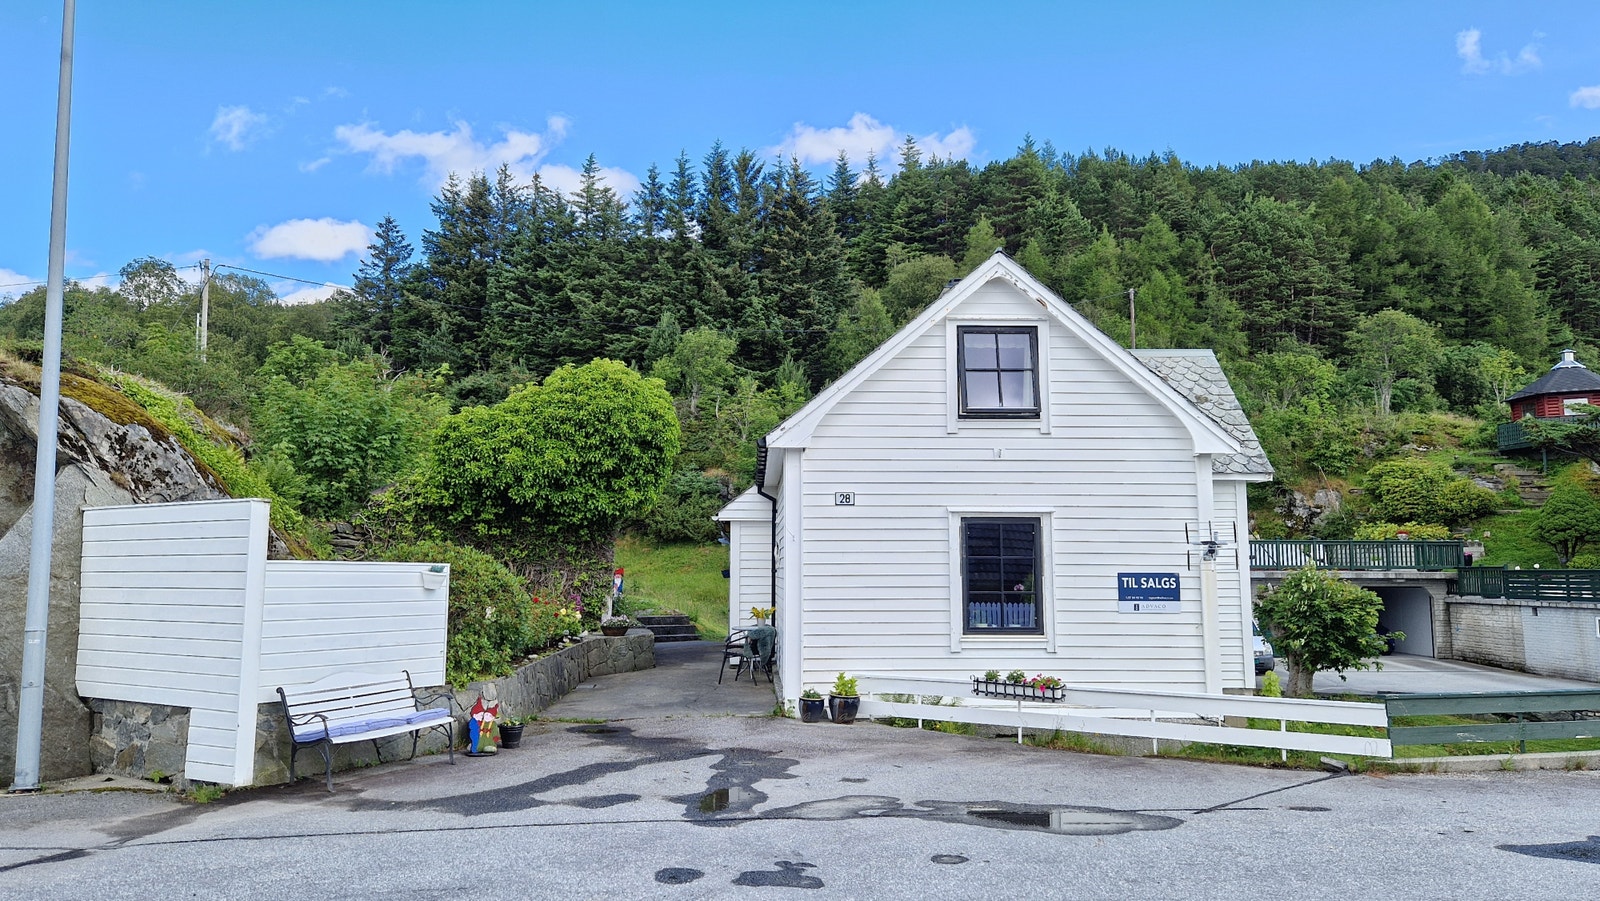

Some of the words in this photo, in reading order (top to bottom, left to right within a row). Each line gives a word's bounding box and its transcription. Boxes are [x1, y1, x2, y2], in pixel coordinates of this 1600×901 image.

[839, 493, 851, 504] 28
[1121, 577, 1138, 588] TIL
[1140, 577, 1177, 589] SALGS
